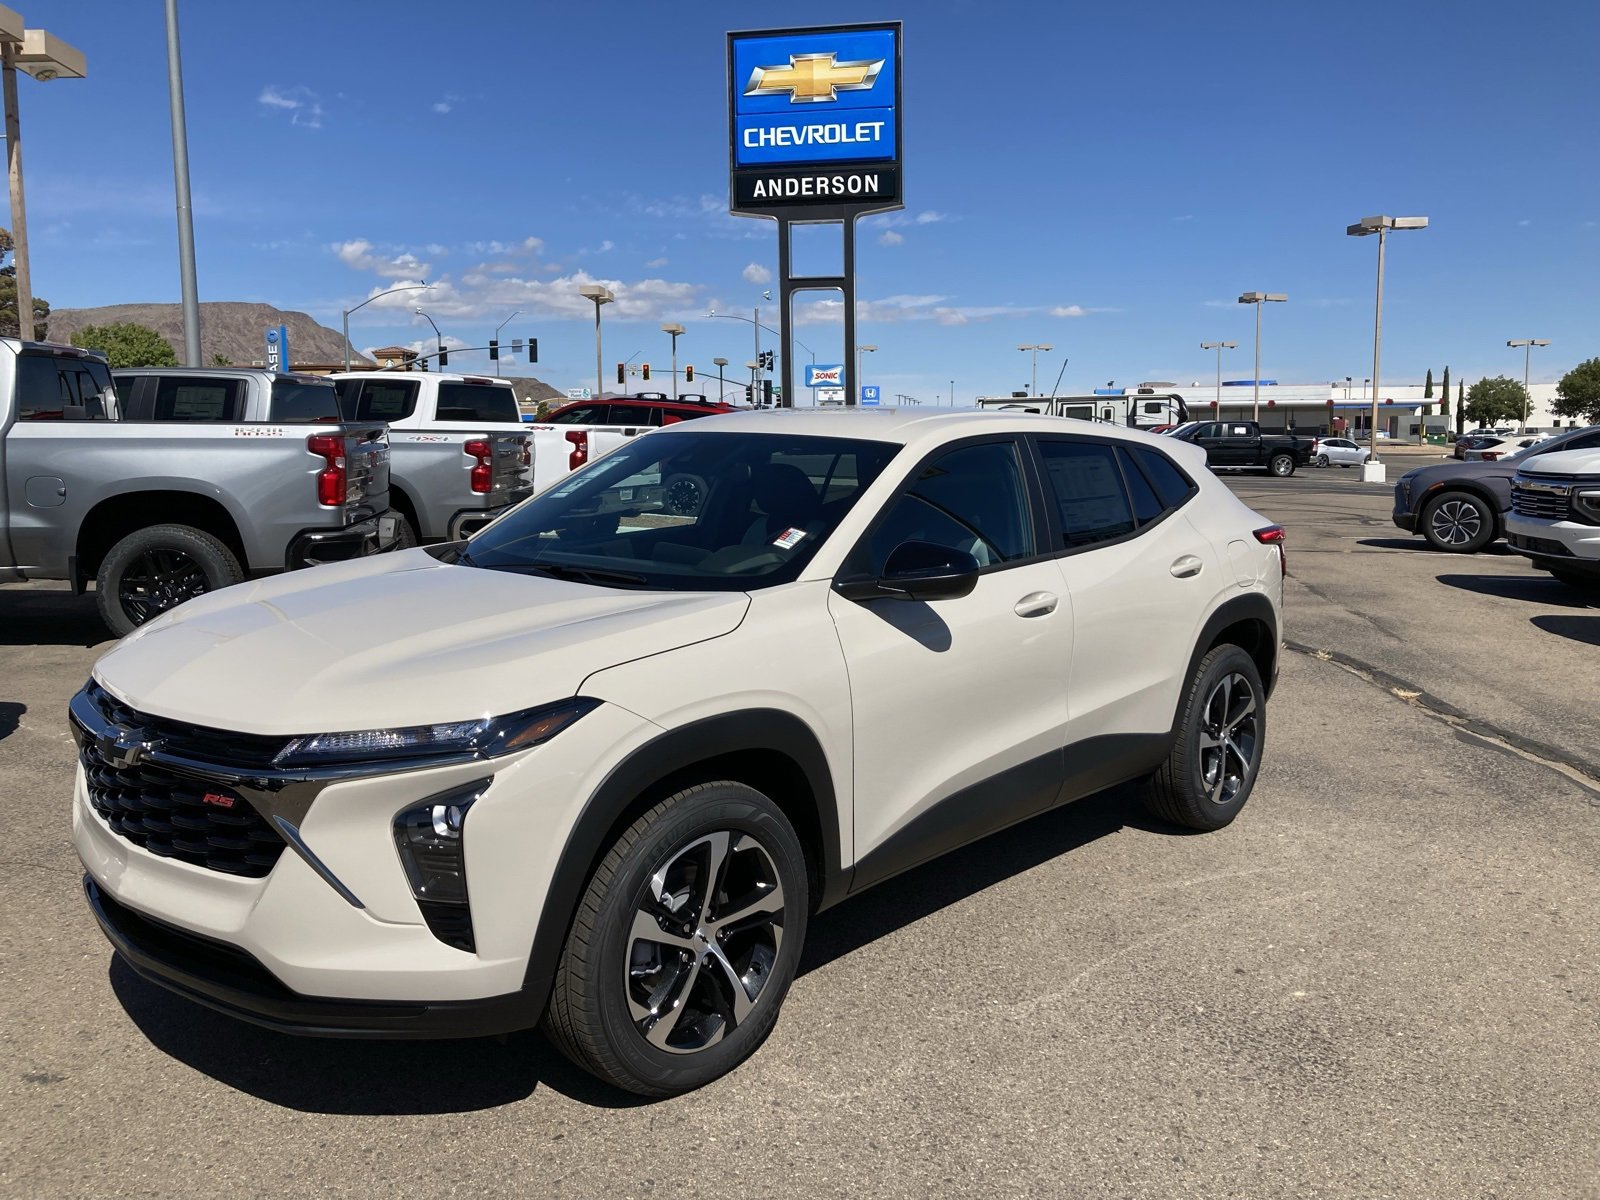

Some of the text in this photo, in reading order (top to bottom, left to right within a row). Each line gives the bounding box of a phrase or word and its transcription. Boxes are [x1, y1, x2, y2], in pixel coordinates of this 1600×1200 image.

[743, 121, 885, 148] CHEVROLET
[753, 174, 879, 198] ANDERSON
[203, 793, 235, 807] RS
